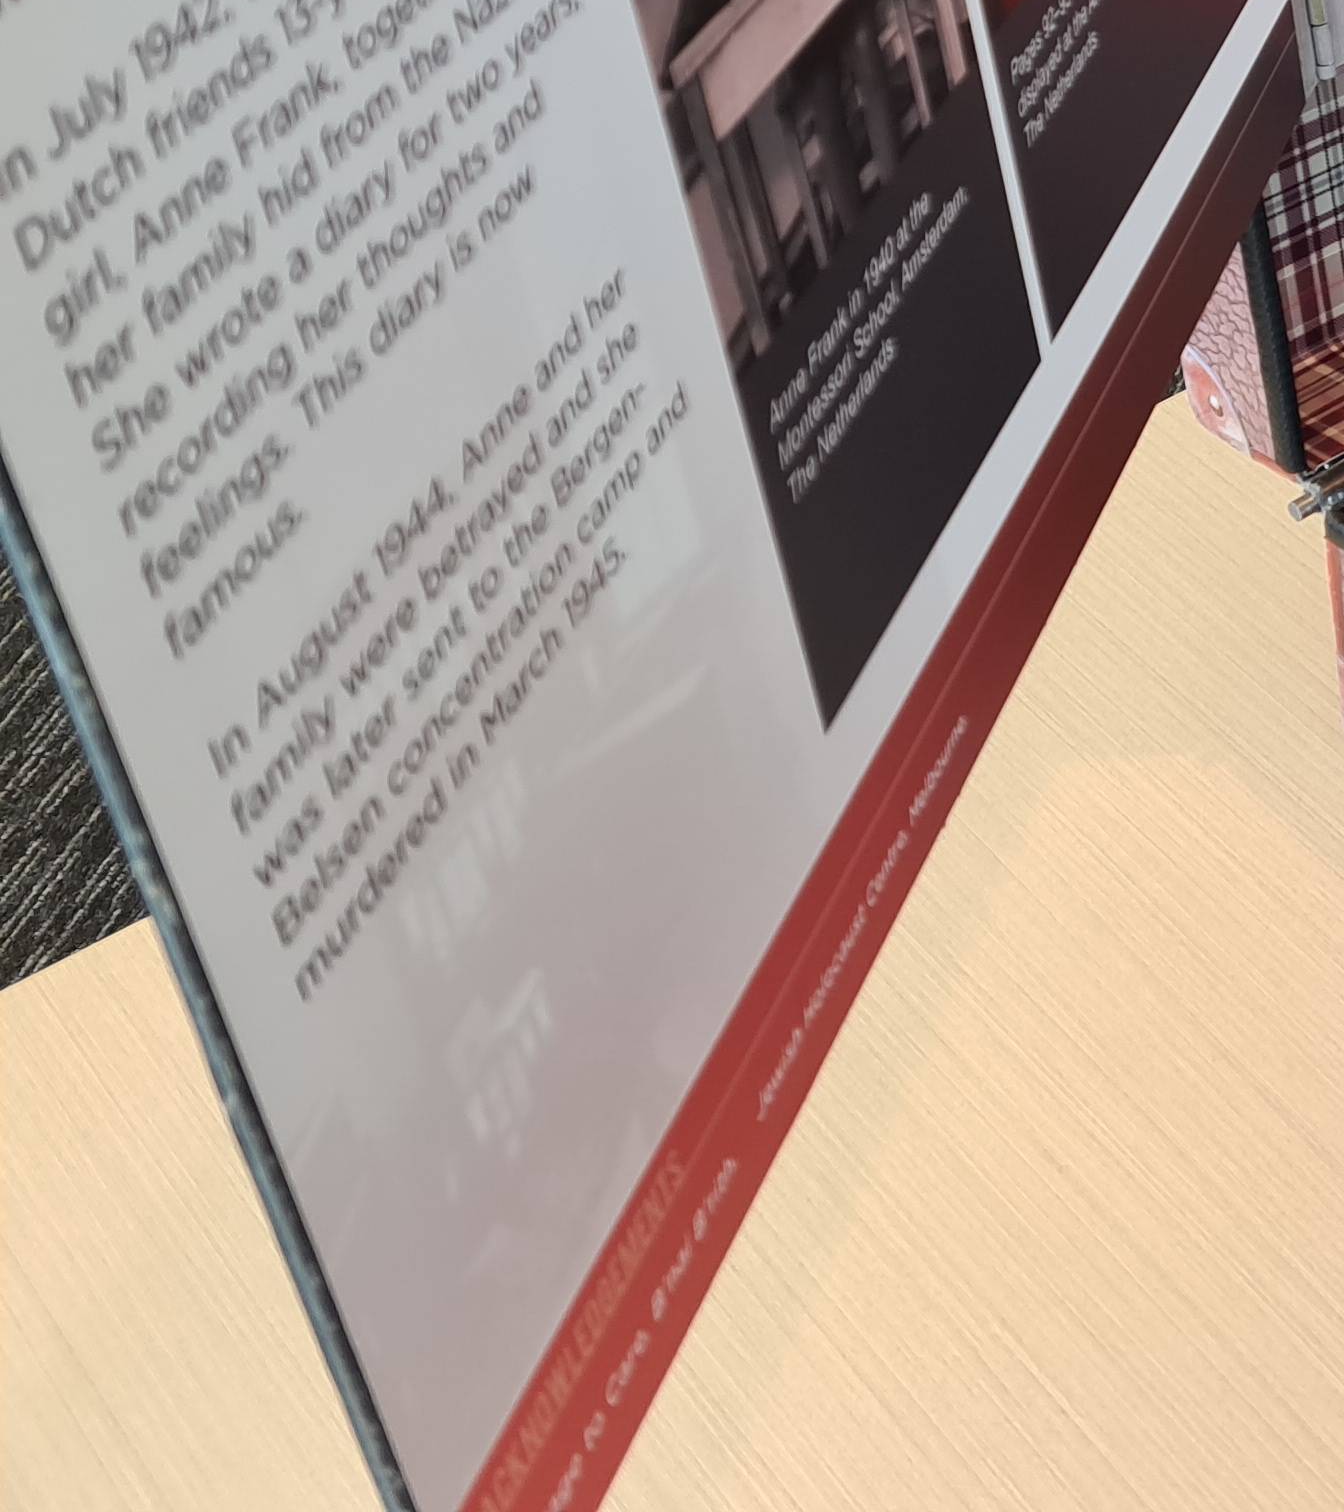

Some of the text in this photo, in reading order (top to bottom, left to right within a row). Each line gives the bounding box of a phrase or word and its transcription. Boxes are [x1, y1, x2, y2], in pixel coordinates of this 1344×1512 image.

[770, 191, 930, 435] Anne Frank in 1940 at the
